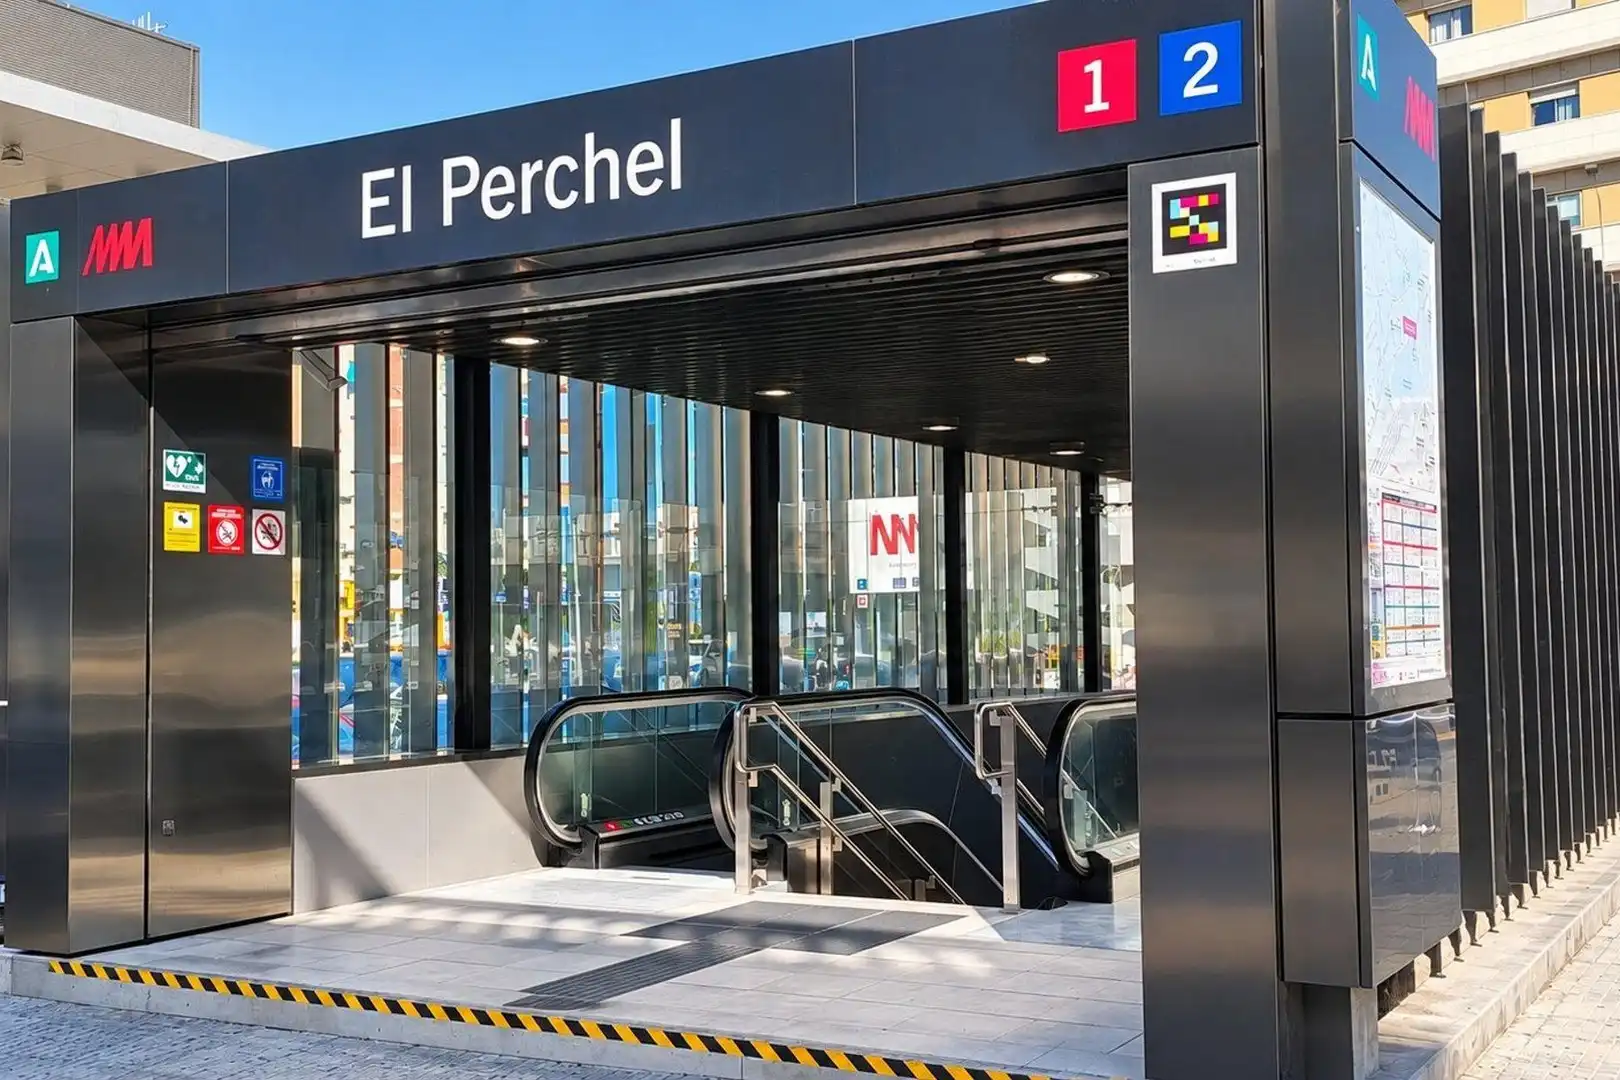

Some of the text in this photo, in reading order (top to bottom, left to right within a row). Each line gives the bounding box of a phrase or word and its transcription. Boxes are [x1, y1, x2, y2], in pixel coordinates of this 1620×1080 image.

[1084, 41, 1218, 113] 1 2
[361, 117, 682, 239] El Perchel
[28, 238, 56, 277] A
